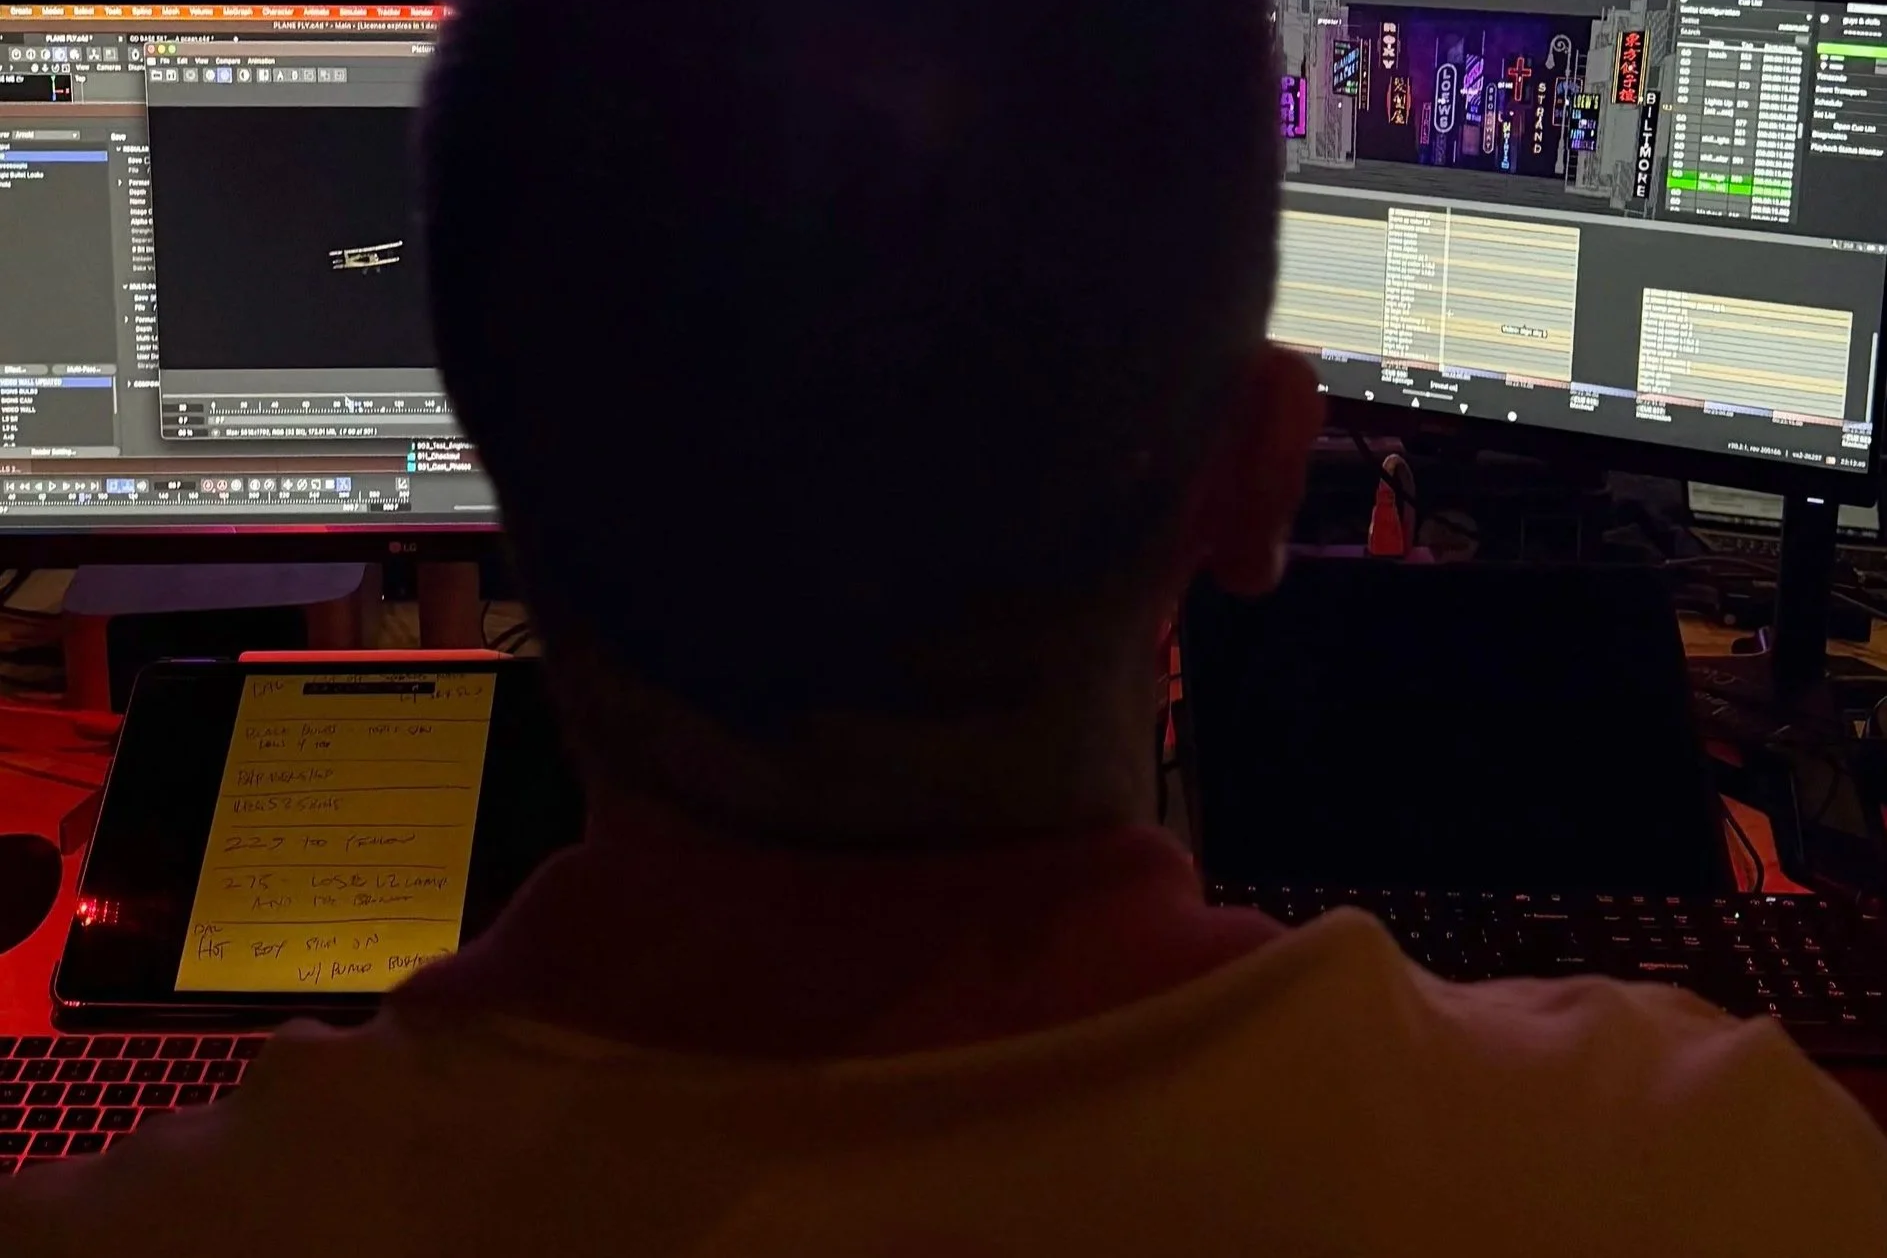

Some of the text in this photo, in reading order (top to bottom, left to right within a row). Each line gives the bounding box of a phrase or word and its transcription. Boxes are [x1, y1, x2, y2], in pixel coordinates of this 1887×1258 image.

[1382, 22, 1397, 69] ROXY
[1533, 82, 1546, 154] STRAND
[1637, 92, 1656, 197] BILTMORE
